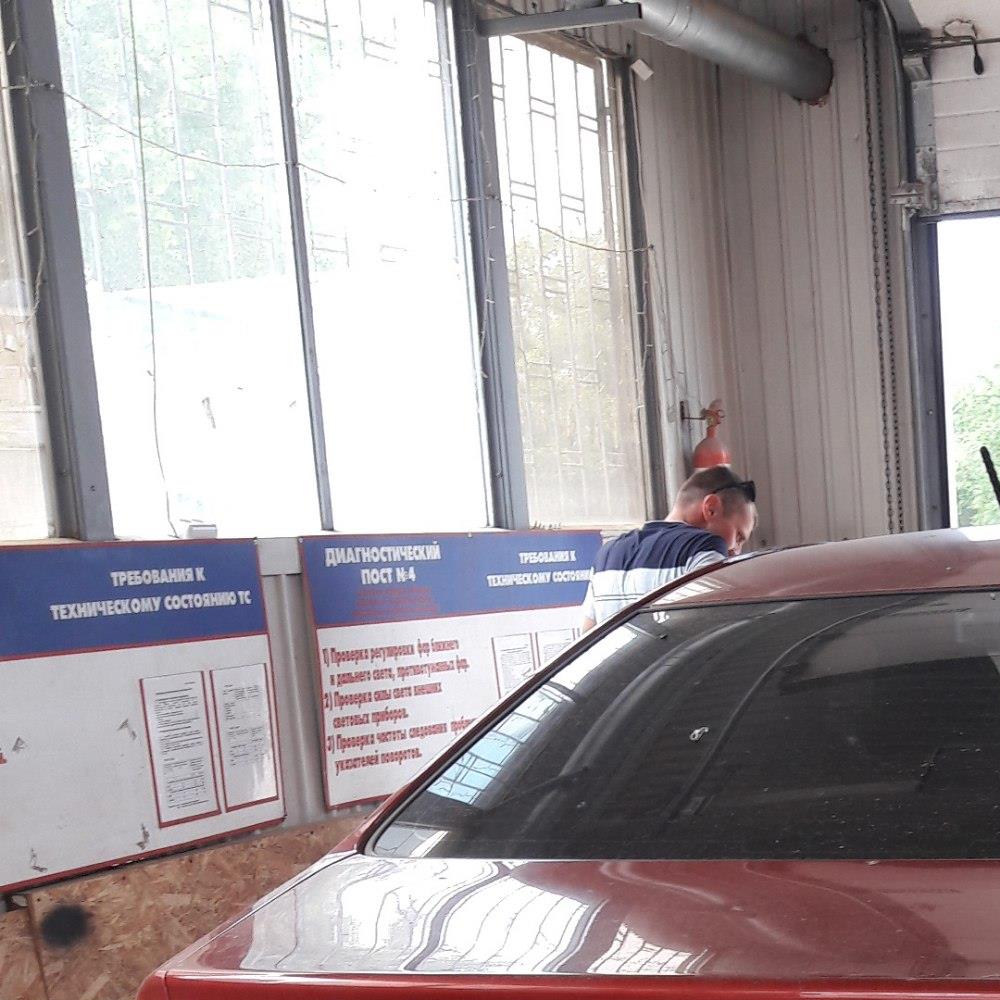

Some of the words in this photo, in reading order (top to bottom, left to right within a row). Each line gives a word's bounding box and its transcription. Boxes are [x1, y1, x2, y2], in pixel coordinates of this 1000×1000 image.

[324, 541, 441, 567] ДИАГНОСТИЧЕСКИЙ
[519, 551, 569, 564] ТРЕБОВАНИЯ
[570, 550, 577, 562] К
[111, 568, 193, 587] ТРЕБОВАНИЯ
[195, 567, 206, 582] К
[361, 568, 394, 585] ПОСТ
[396, 567, 416, 584] №4
[487, 572, 551, 587] ТЕХНИЧЕСКОМУ
[50, 597, 161, 620] ТЕХНИЧЕСКОМУ
[164, 592, 236, 611] СОСТОЯНИЮ
[237, 590, 252, 605] ТС
[331, 647, 369, 667] Проверка
[334, 691, 372, 710] Проверка
[336, 734, 374, 753] Проверка
